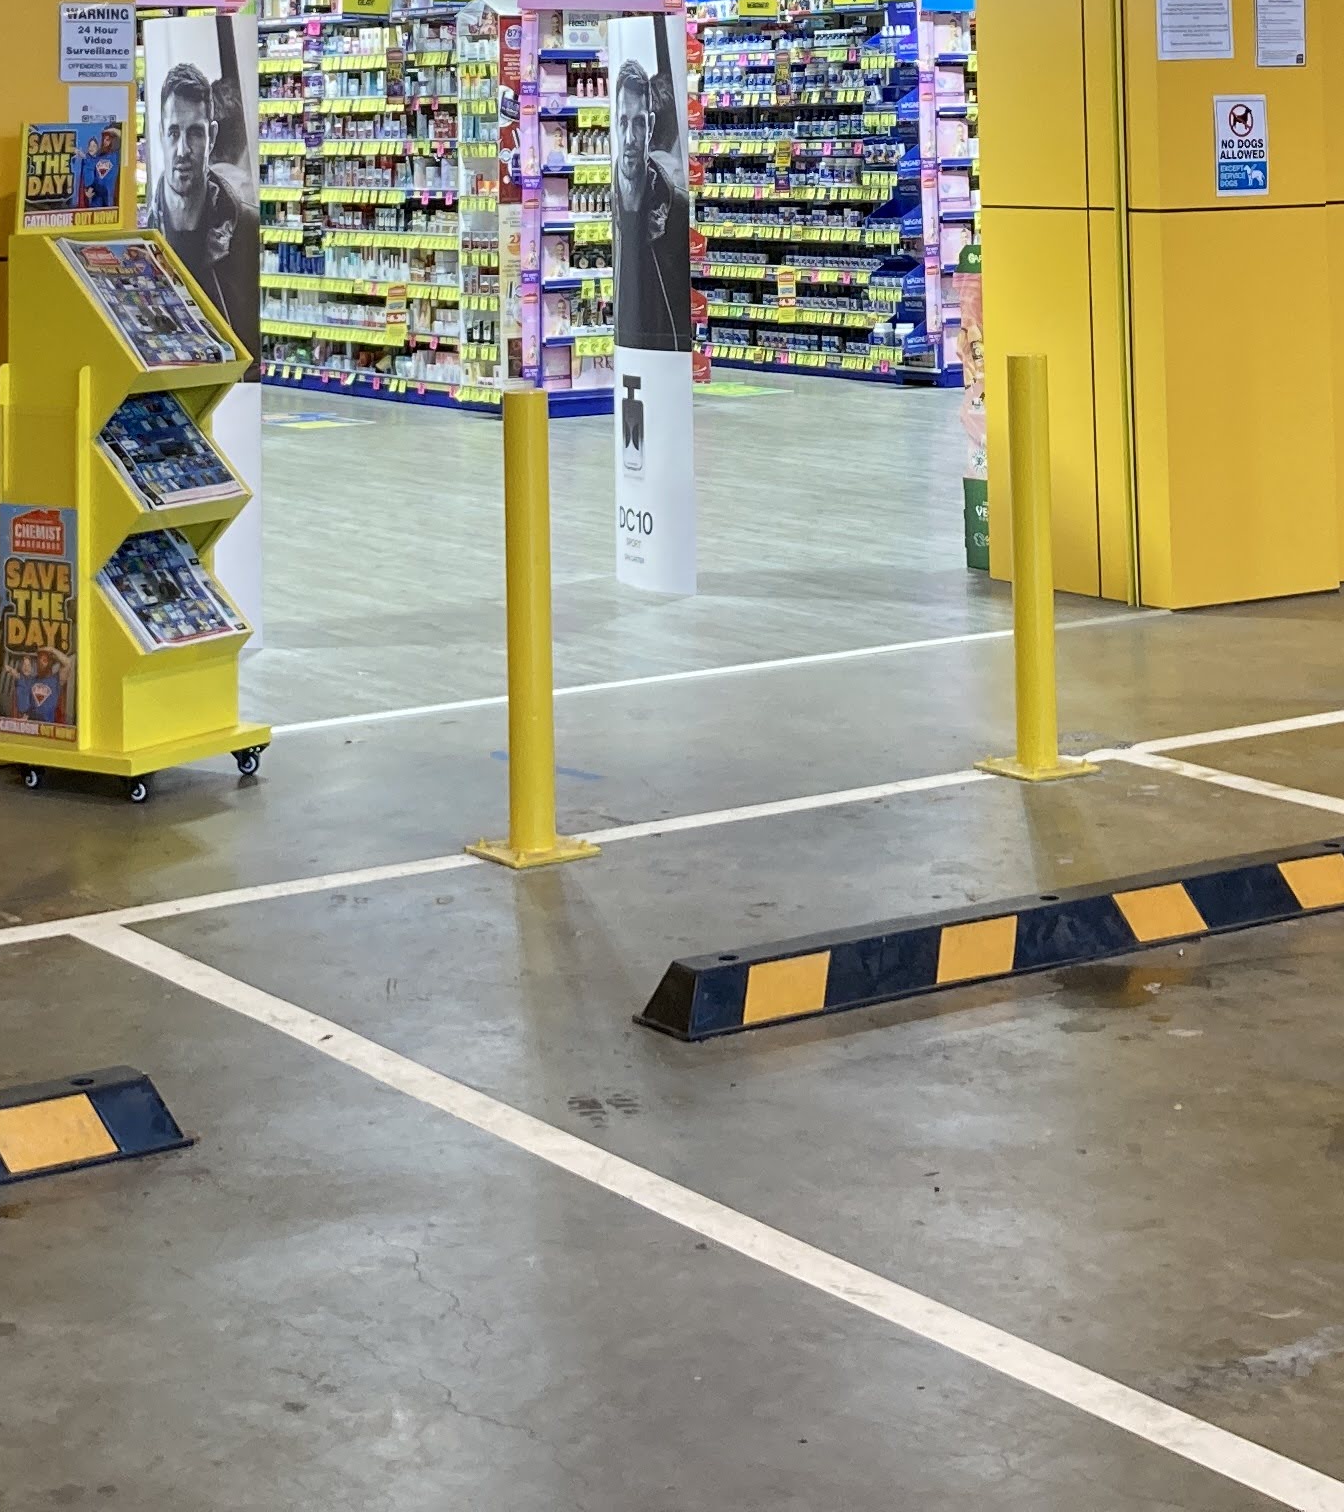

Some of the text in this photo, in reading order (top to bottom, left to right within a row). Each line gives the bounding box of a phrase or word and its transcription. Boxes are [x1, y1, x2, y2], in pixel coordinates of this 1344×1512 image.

[66, 8, 129, 20] WARNING
[77, 26, 119, 34] 24 Hour
[84, 36, 113, 45] Video
[66, 46, 130, 55] Surveillance
[28, 132, 76, 155] SAVE
[1221, 139, 1264, 149] NO DOGS
[1220, 149, 1265, 159] ALLOWED
[32, 153, 71, 175] THE
[27, 174, 74, 197] DAY!
[25, 213, 74, 227] CATALOGUE
[75, 211, 93, 226] OUT
[619, 505, 653, 535] DC10
[14, 523, 61, 541] CHEMIST
[6, 558, 71, 593] SAVE
[13, 589, 66, 622] THE
[7, 617, 69, 651] DAY!
